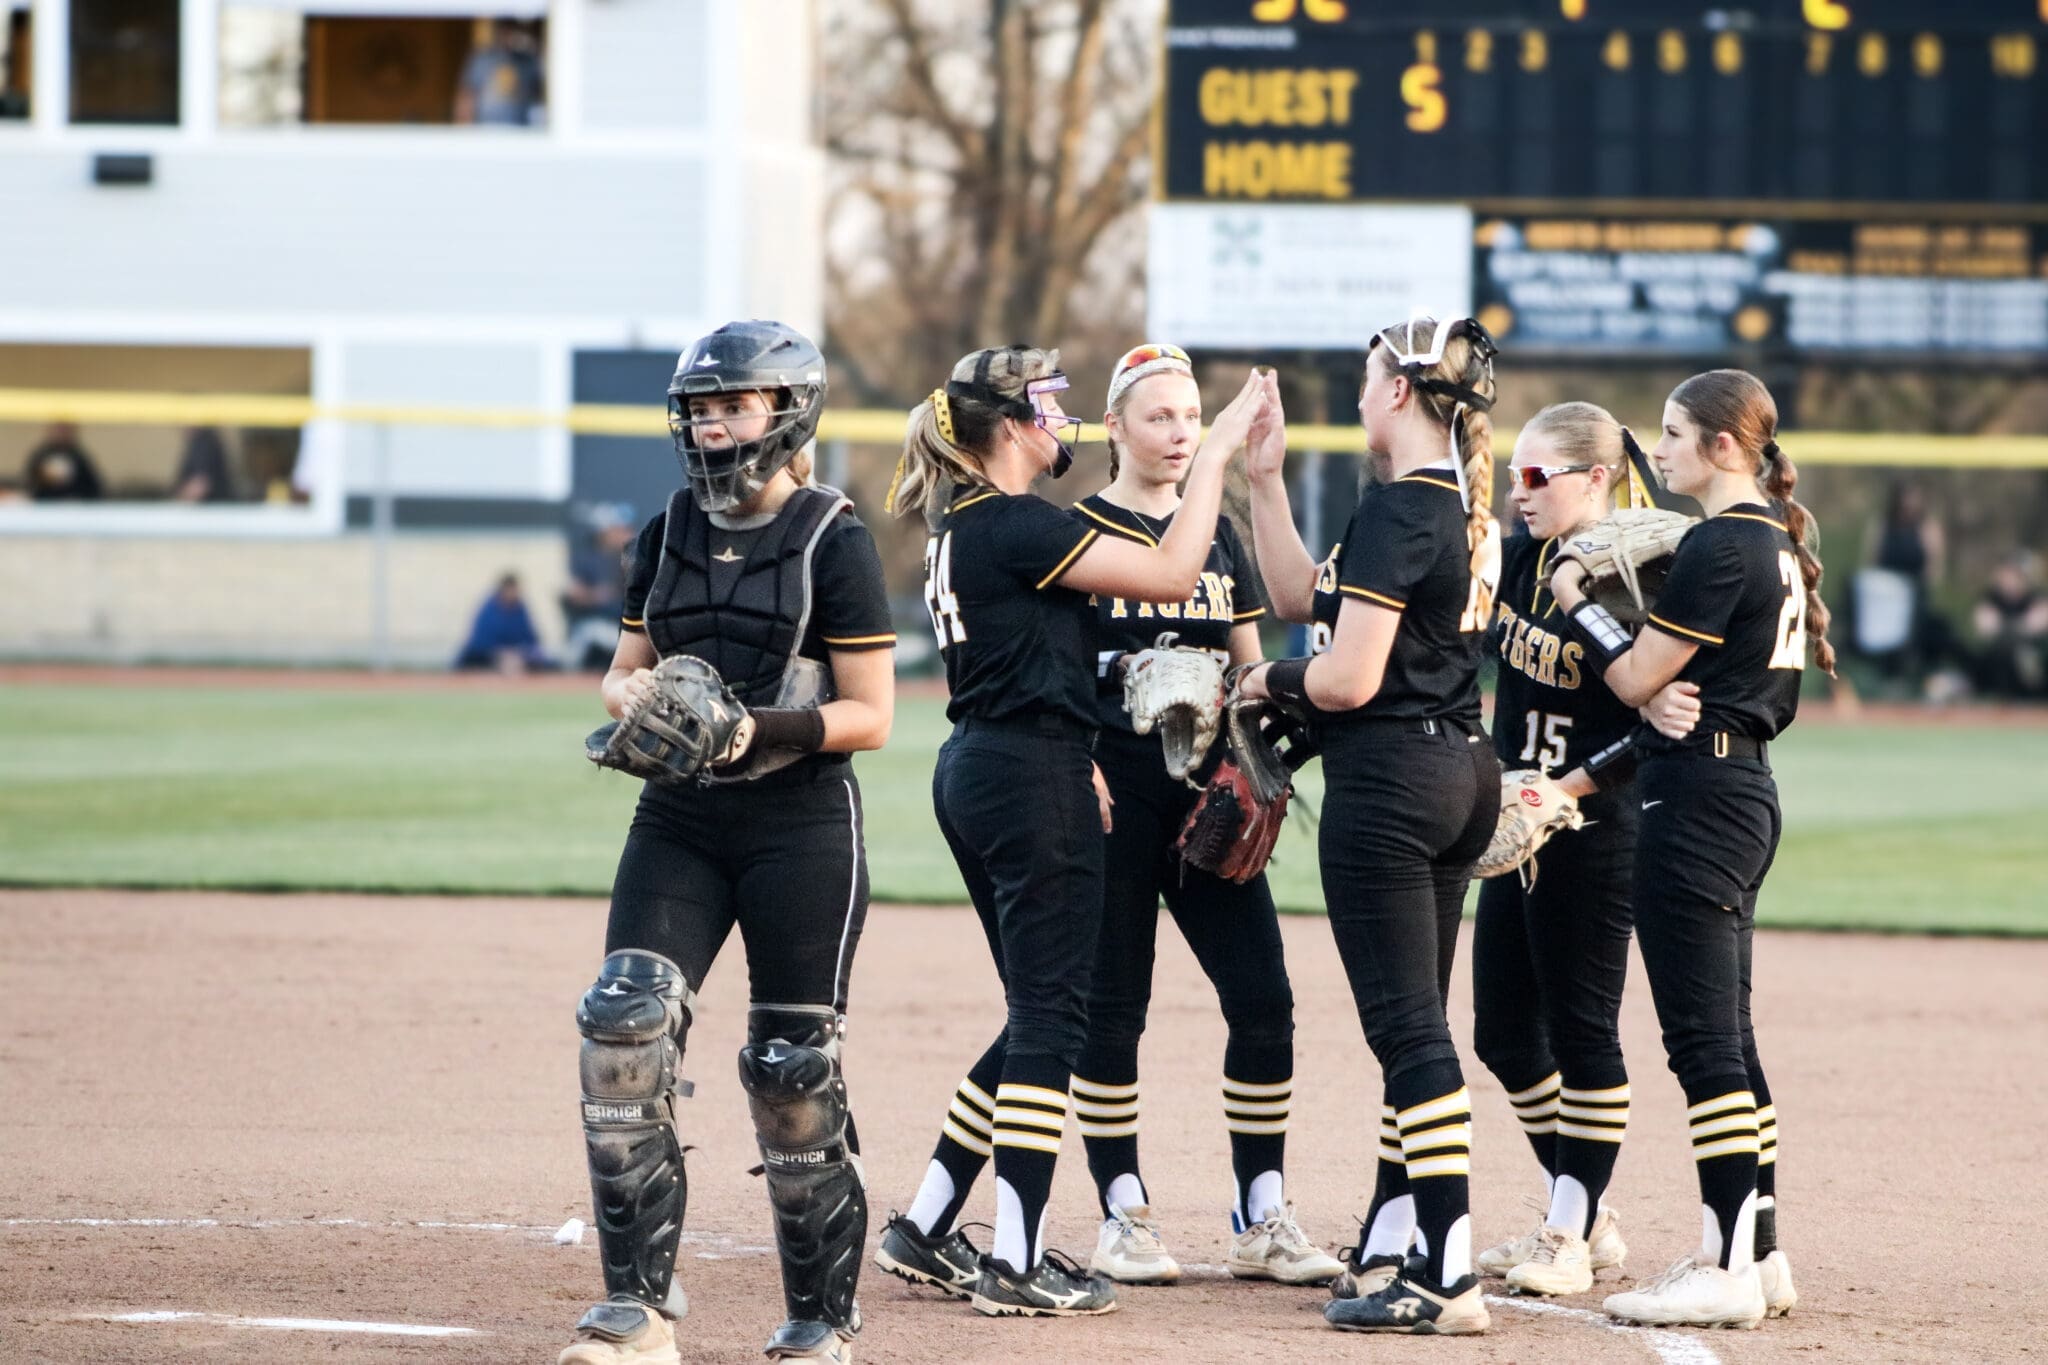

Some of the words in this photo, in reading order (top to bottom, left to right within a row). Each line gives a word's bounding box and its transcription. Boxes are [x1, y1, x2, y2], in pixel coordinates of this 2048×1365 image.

[1199, 67, 1358, 126] GUEST
[1203, 140, 1352, 198] HOME
[1519, 710, 1573, 767] 15
